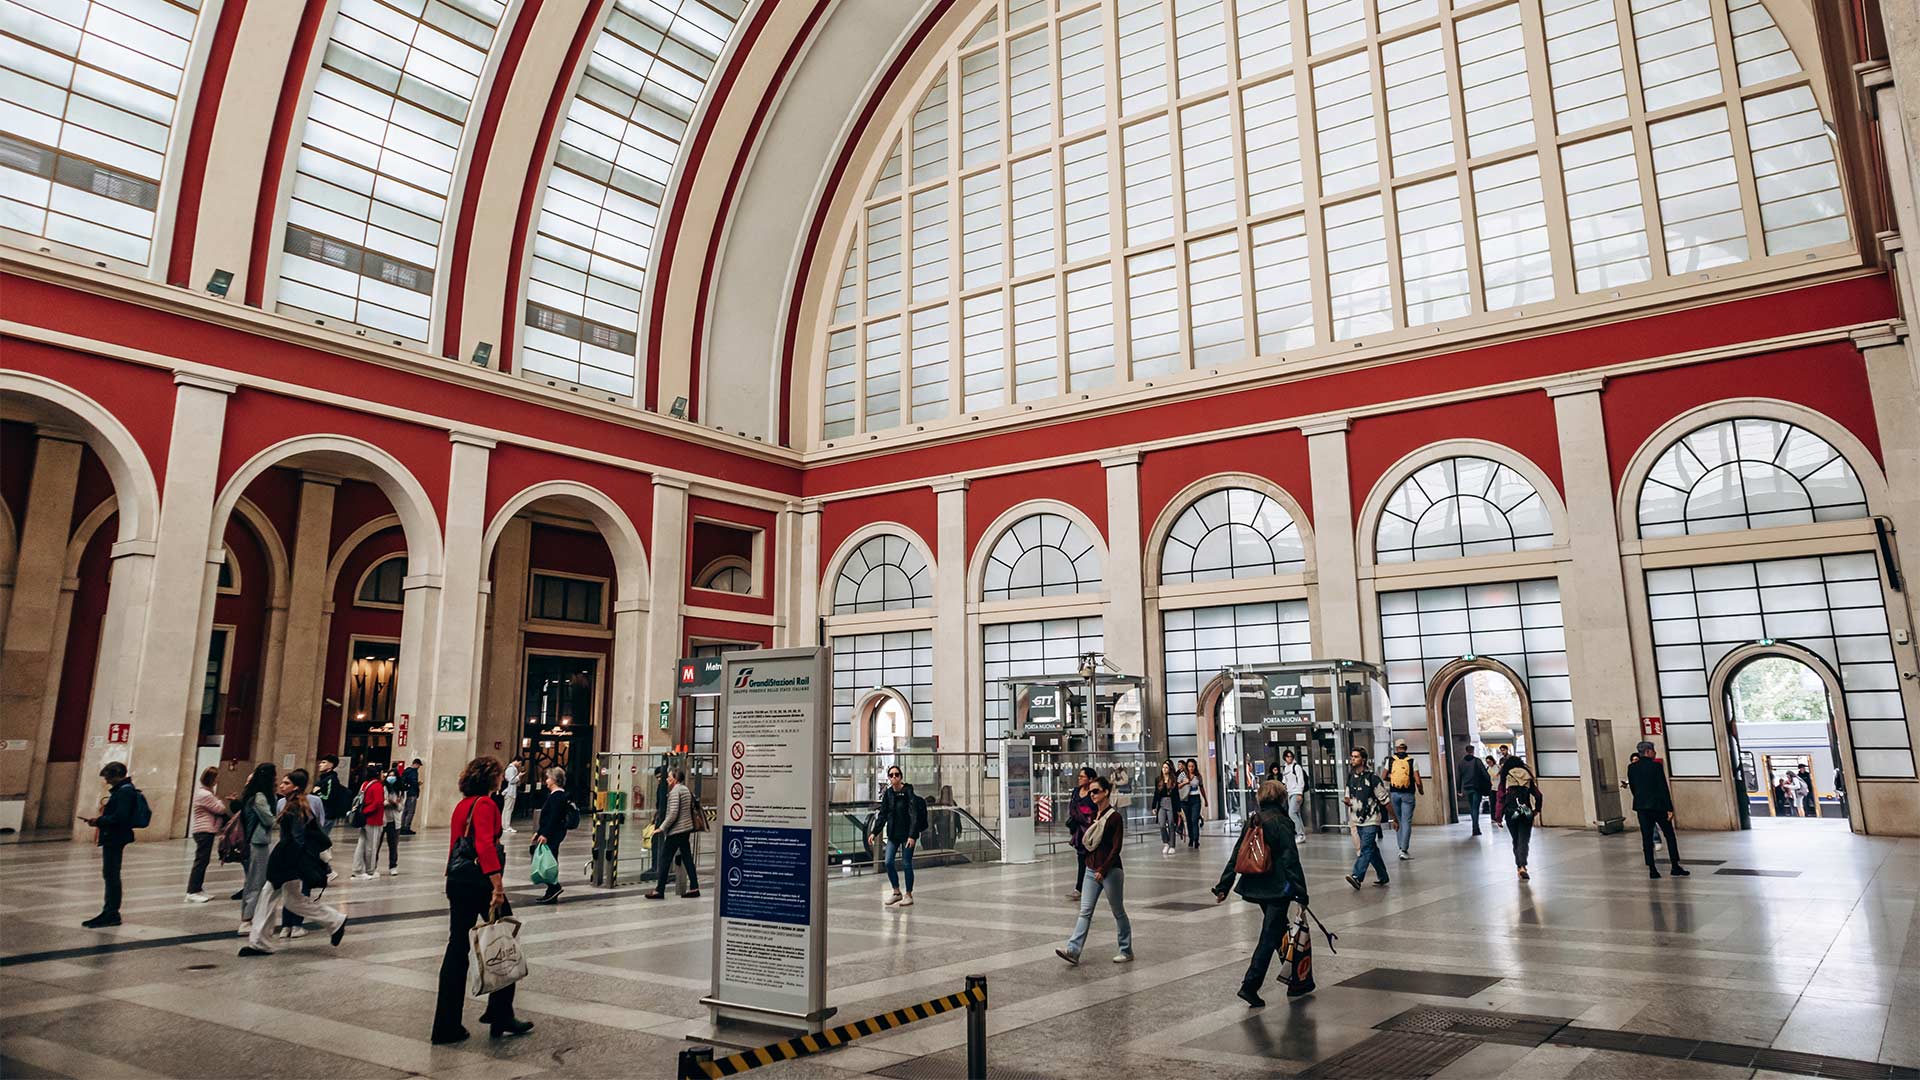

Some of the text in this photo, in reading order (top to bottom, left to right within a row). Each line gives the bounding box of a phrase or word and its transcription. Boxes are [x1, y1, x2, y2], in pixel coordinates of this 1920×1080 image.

[683, 669, 694, 680] M
[749, 676, 810, 687] GrandiStazioni Rail
[1271, 685, 1298, 696] GTT
[1032, 696, 1053, 705] GTT
